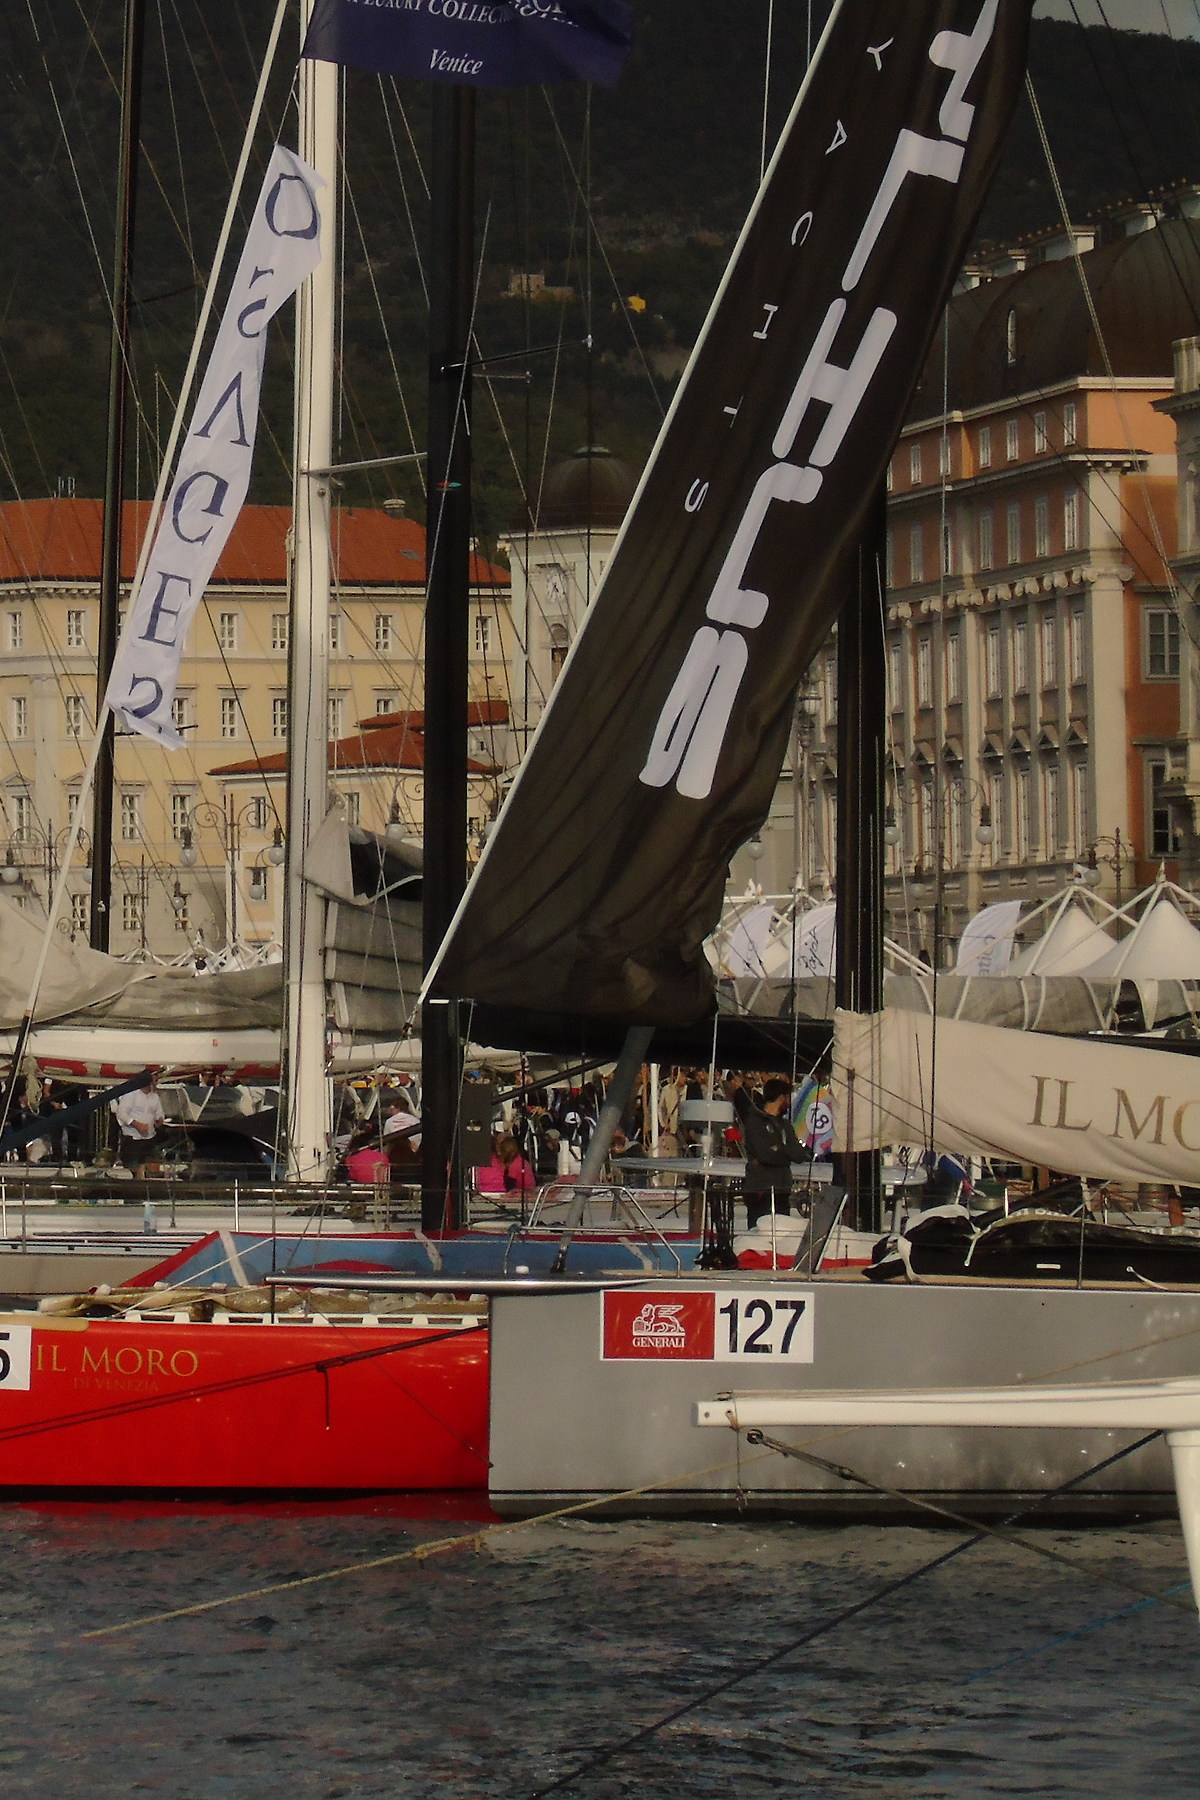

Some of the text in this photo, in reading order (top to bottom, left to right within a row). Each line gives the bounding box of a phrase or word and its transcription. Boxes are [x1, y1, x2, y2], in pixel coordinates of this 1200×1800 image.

[428, 49, 484, 75] Venice
[684, 36, 894, 513] YACHTS
[1026, 1074, 1093, 1132] IL
[631, 1336, 686, 1349] GENERALI
[719, 1298, 807, 1355] 127
[36, 1344, 199, 1378] IL MORO
